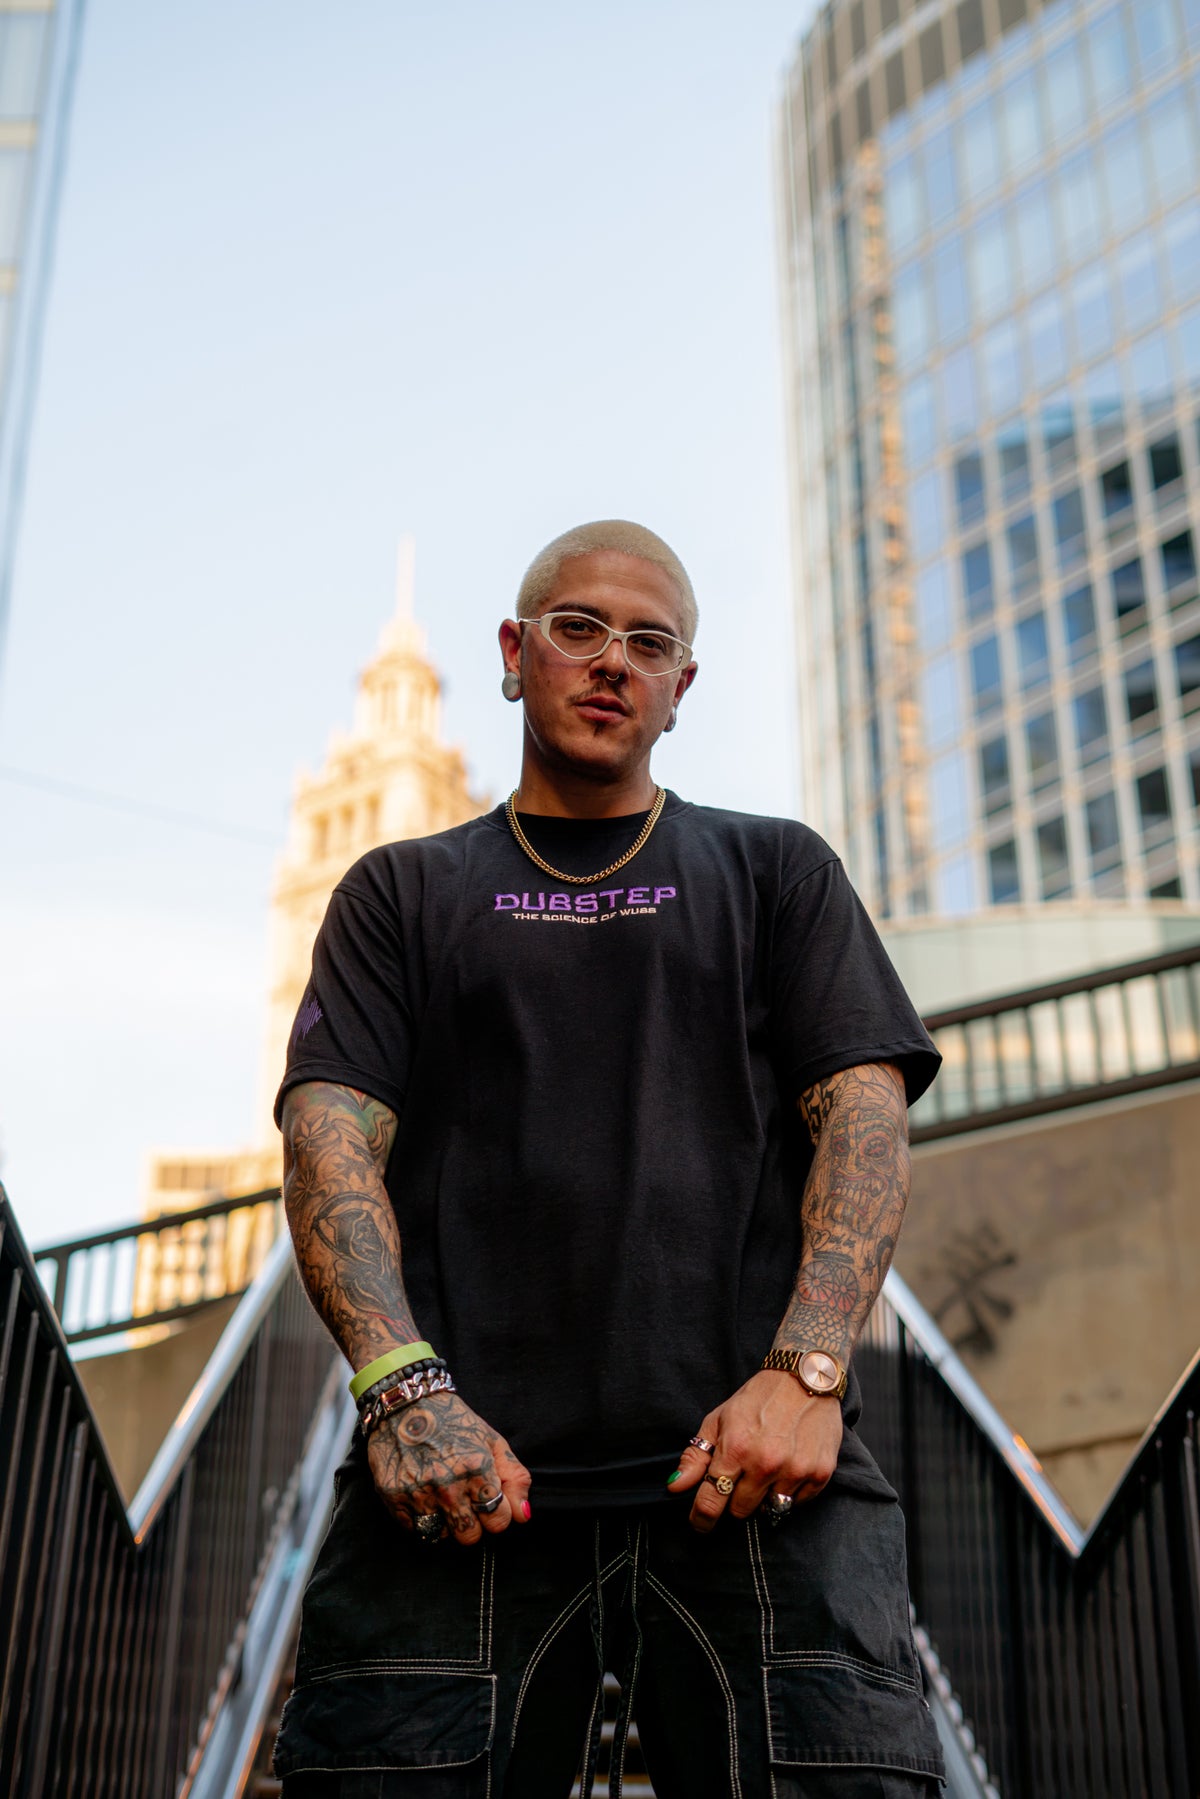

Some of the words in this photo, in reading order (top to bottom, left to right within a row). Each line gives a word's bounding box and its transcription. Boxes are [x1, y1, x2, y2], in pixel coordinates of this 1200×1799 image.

[494, 886, 676, 913] DUBSTEP
[512, 913, 540, 921] THE
[542, 914, 598, 924] SCIENCE
[601, 911, 617, 922] OF
